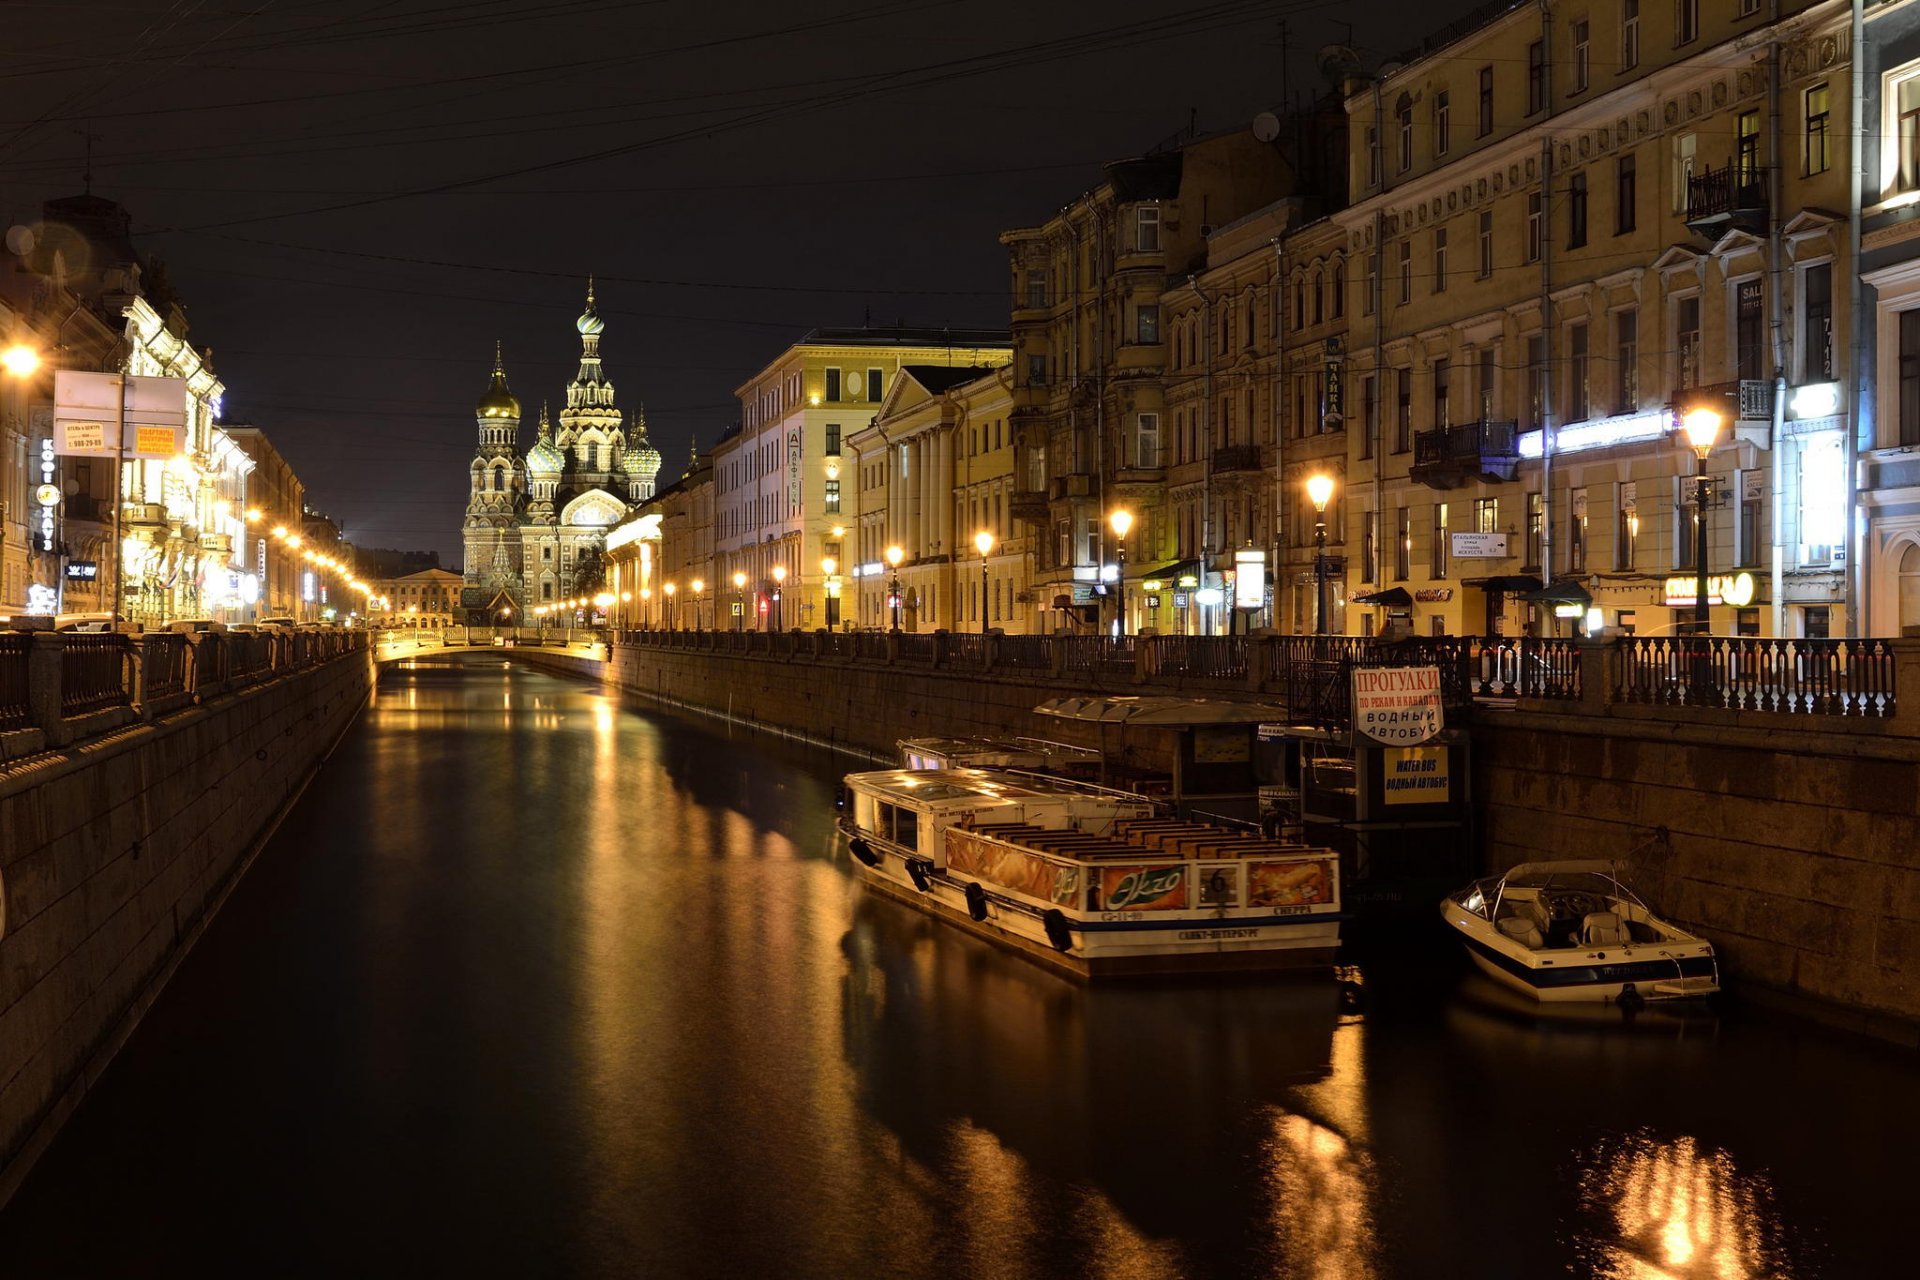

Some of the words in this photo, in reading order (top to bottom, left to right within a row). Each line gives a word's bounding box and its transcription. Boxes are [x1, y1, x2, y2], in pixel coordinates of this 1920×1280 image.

[1328, 363, 1338, 413] ЧАЙКА
[1357, 670, 1440, 692] ПРОГУЛКИ
[1360, 698, 1369, 708] ПО
[1372, 696, 1395, 708] РЕКАМ
[1397, 696, 1403, 707] И
[1404, 694, 1440, 707] КАНАЛАМ
[1367, 709, 1435, 724] ВОДНЫЙ
[1368, 723, 1436, 738] АВТОБУС
[1396, 760, 1420, 773] WATER
[1421, 759, 1437, 772] BUS
[1386, 775, 1417, 791] ВОДНЫЙ
[1417, 776, 1448, 789] АВТОБУС
[1211, 868, 1226, 893] 6
[1178, 929, 1258, 940] САНКТ-ПЕТЕРБУРГ
